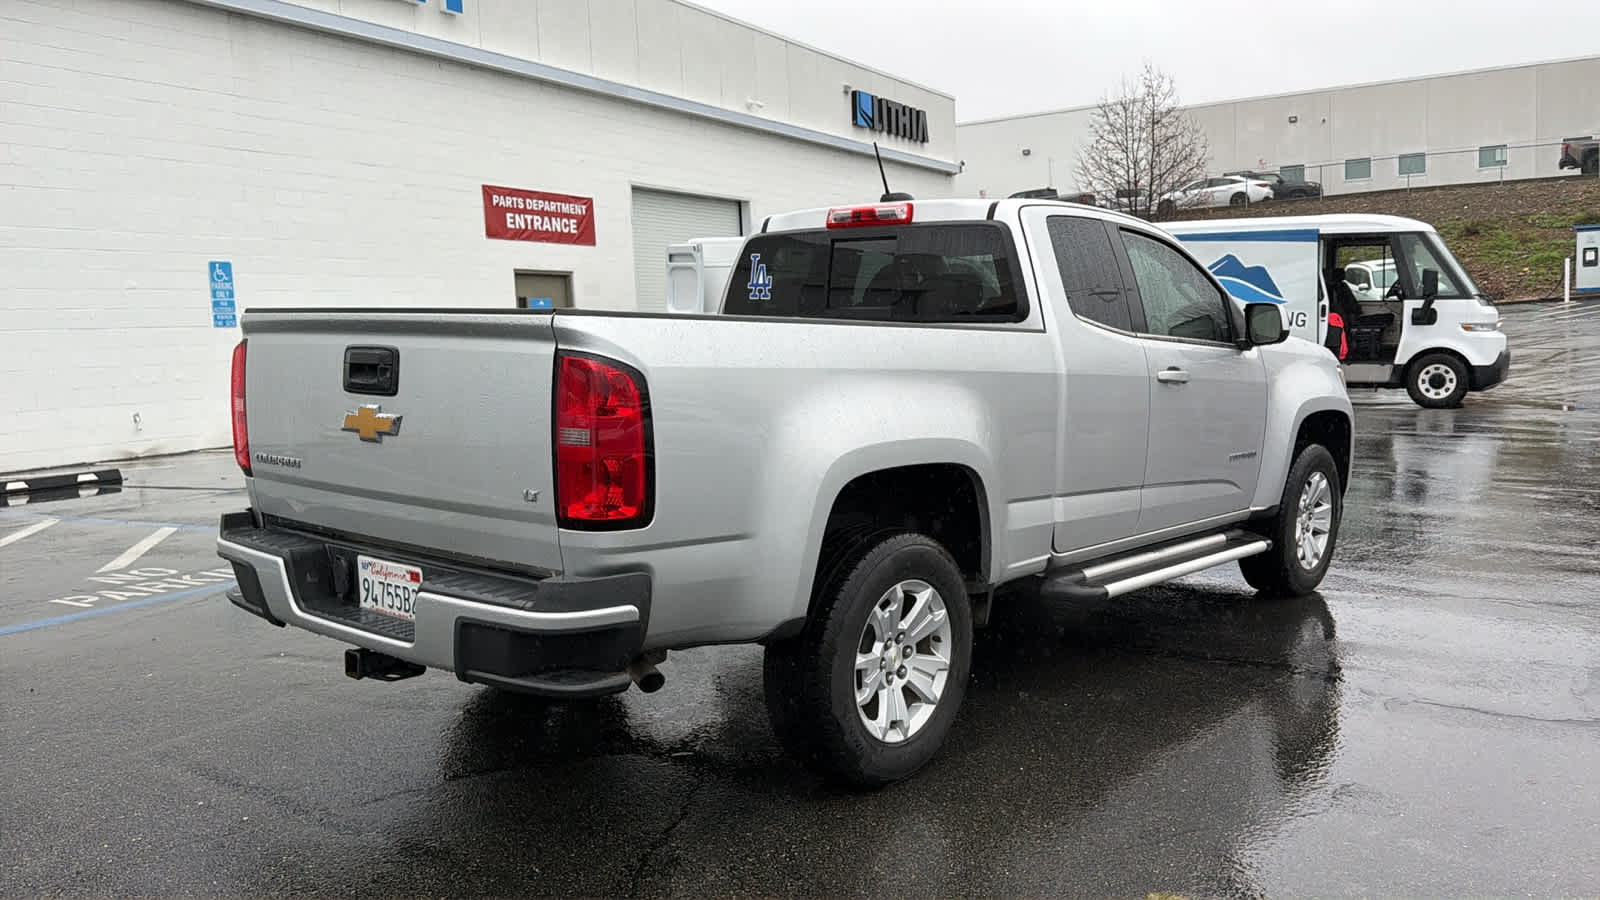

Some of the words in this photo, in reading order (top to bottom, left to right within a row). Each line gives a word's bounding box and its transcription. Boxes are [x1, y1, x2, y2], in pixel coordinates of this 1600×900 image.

[872, 95, 930, 143] LITHIA
[492, 194, 524, 210] PARTS
[526, 198, 587, 216] DEPARTMENT
[505, 212, 578, 234] ENTRANCE
[748, 253, 773, 300] LA
[87, 567, 179, 585] NO
